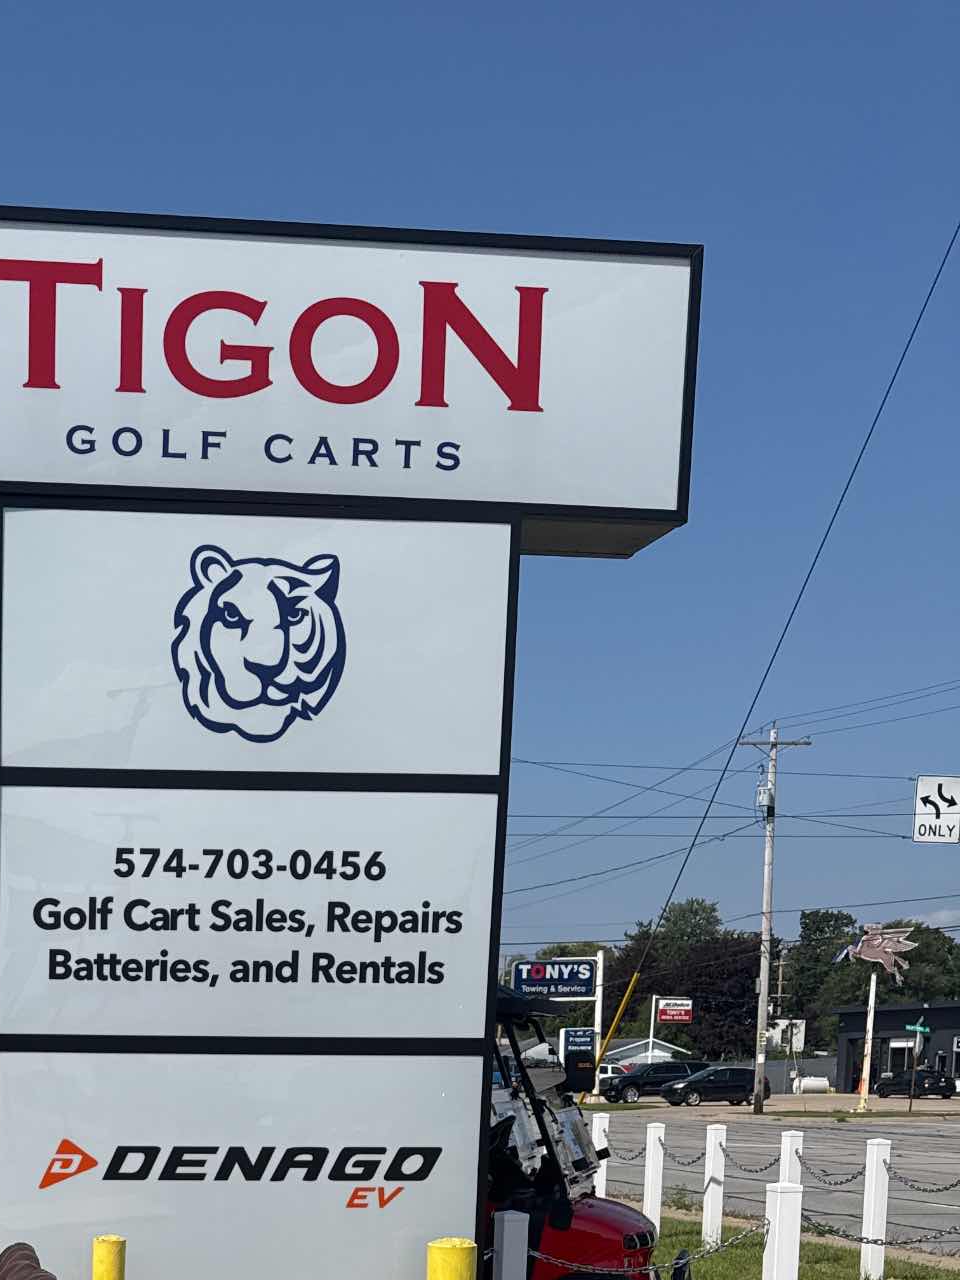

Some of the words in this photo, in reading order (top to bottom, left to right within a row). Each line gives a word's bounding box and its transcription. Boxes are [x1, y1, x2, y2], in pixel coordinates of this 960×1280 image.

[65, 424, 227, 461] GOLF
[263, 433, 462, 471] CARTS
[918, 824, 956, 838] ONLY
[113, 847, 387, 881] 574-703-0456
[32, 896, 114, 931] Golf
[123, 899, 200, 932] Cart
[209, 899, 315, 938] Sales,
[326, 901, 463, 942] Repairs
[47, 948, 219, 987] Batteries,
[229, 950, 300, 983] and
[311, 951, 446, 985] Rentals
[518, 963, 591, 980] TONY'S
[522, 984, 548, 994] Towing
[558, 984, 587, 993] Service
[102, 1146, 443, 1182] DENAGO
[345, 1186, 405, 1209] EV
